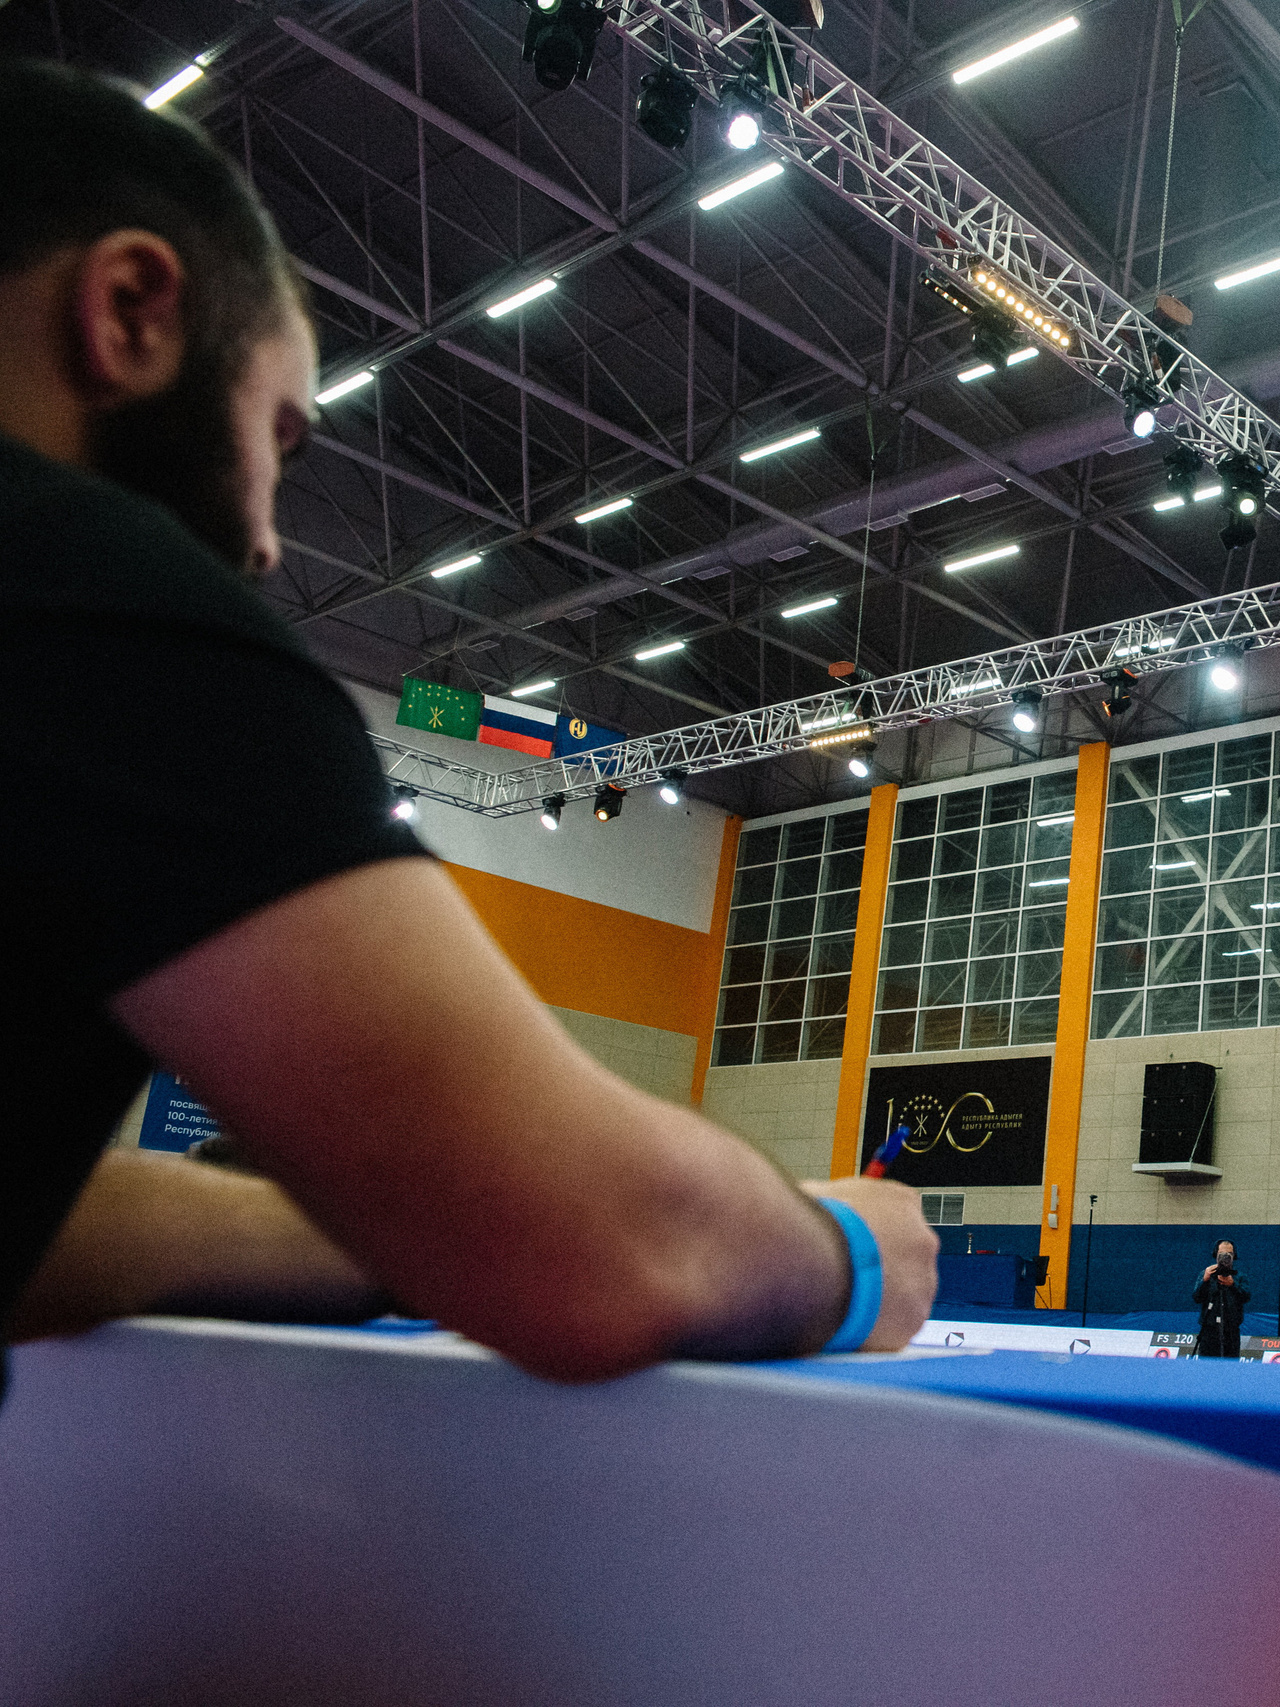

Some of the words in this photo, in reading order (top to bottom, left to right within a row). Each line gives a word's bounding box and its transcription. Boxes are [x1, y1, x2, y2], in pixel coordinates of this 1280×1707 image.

[169, 1100, 211, 1112] посвящ
[167, 1111, 218, 1126] 100-летия
[1156, 1334, 1170, 1343] FS
[1174, 1334, 1194, 1344] 120
